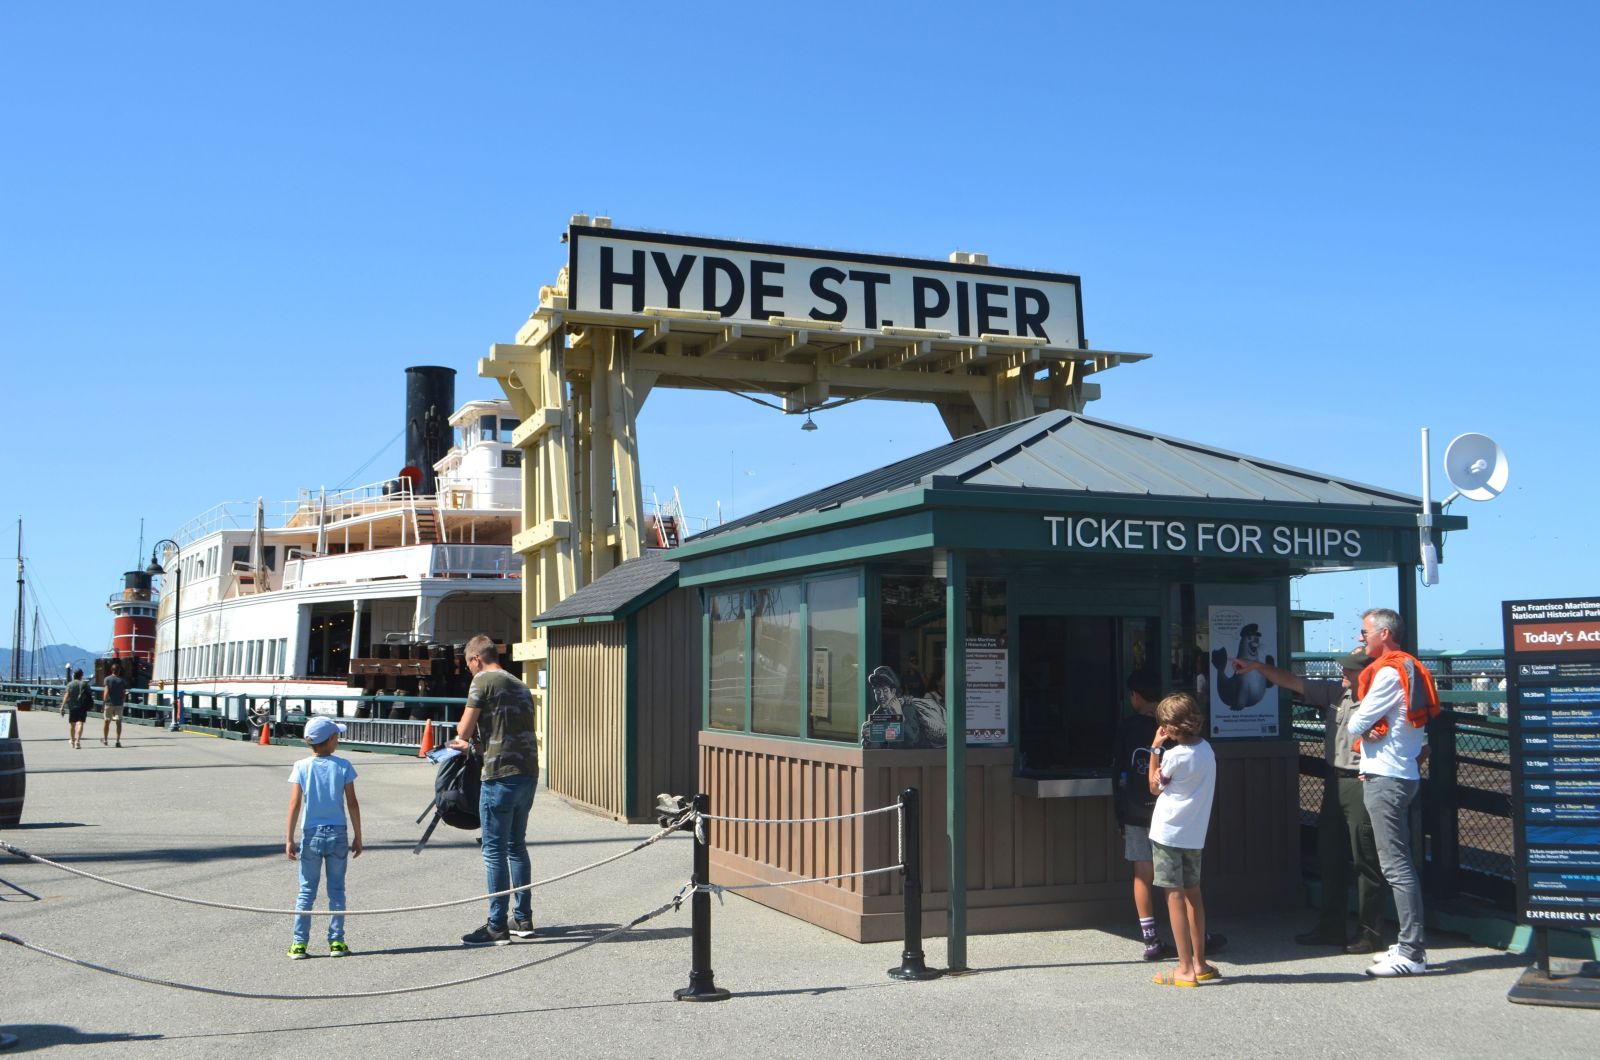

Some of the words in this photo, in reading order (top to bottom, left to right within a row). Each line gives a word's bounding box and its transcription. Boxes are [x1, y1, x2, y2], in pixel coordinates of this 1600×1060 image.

[600, 246, 785, 321] HYDE
[809, 266, 894, 330] ST.
[912, 275, 1051, 344] PIER
[1043, 516, 1187, 551] TICKETS
[1197, 523, 1264, 554] FOR
[1272, 526, 1362, 558] SHIPS
[1523, 631, 1574, 645] Today's
[1526, 911, 1586, 920] EXPERIENCE
